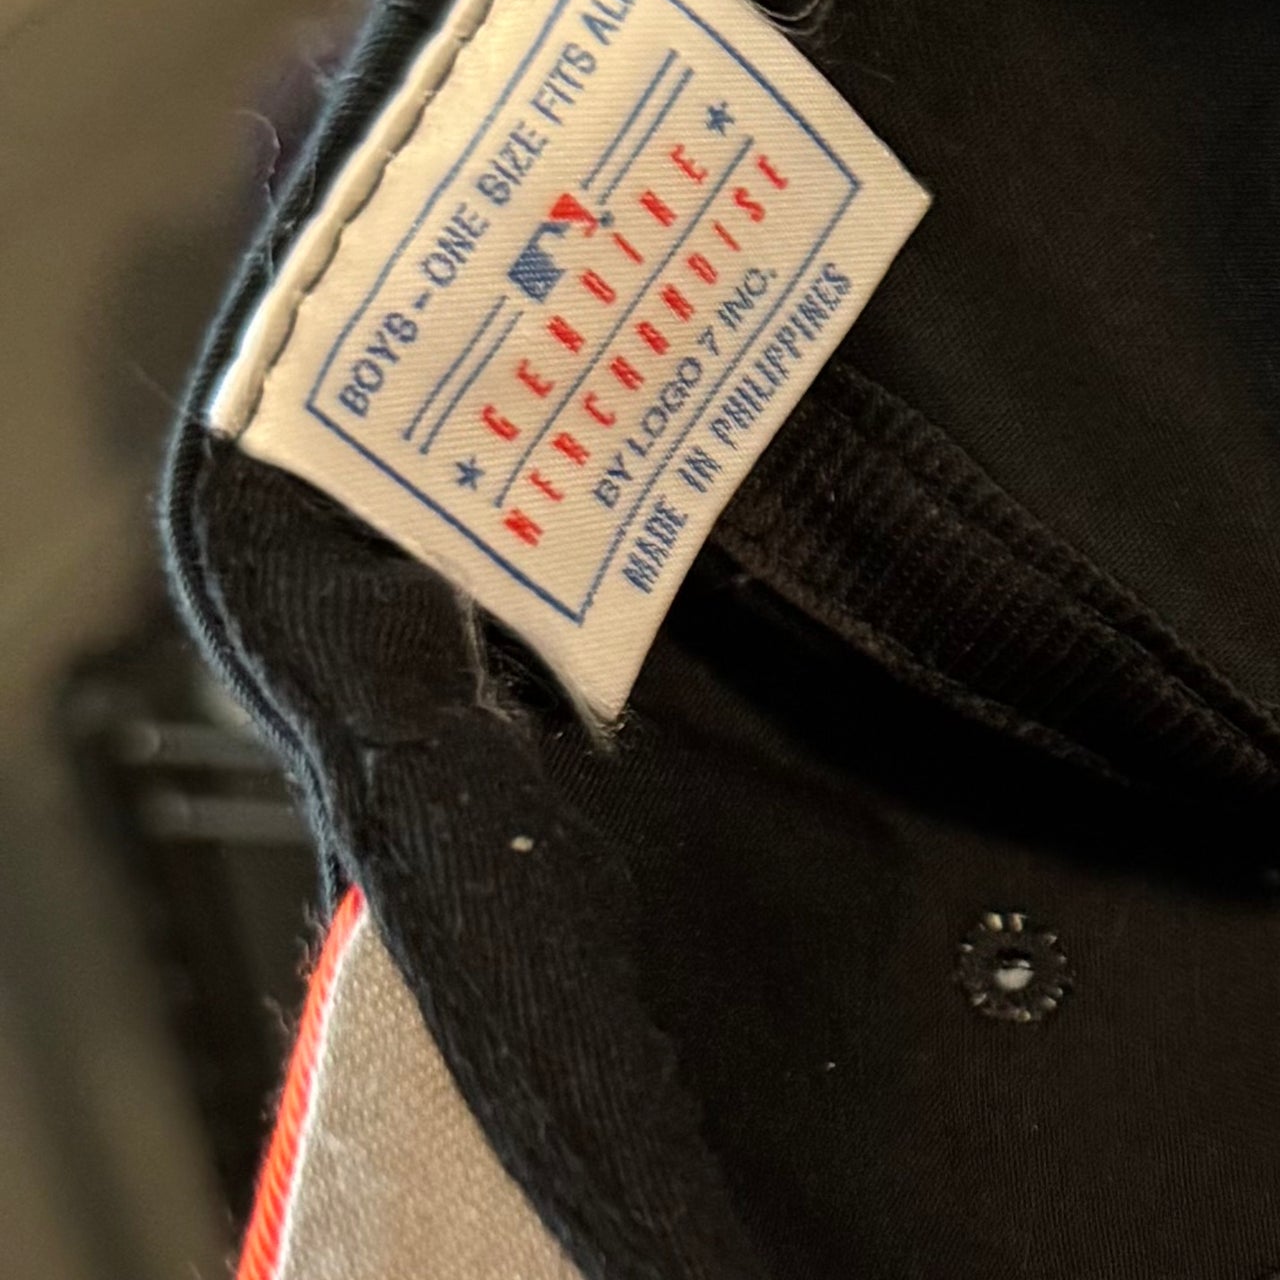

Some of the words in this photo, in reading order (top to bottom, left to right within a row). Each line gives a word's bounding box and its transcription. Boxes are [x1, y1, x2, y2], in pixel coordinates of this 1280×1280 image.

[339, 311, 419, 417] BOYS
[420, 203, 491, 288] ONE
[476, 121, 550, 206] SIZE
[531, 43, 598, 125] FITS
[481, 144, 707, 442] GENUINE
[504, 155, 789, 547] MERCHANDISE
[592, 454, 633, 509] BY
[626, 356, 703, 459] LOGO
[699, 326, 719, 356] 7
[717, 266, 778, 330] INC.
[622, 496, 689, 593] MADE
[678, 447, 722, 493] IN
[711, 262, 851, 450] PHILIPPINES
